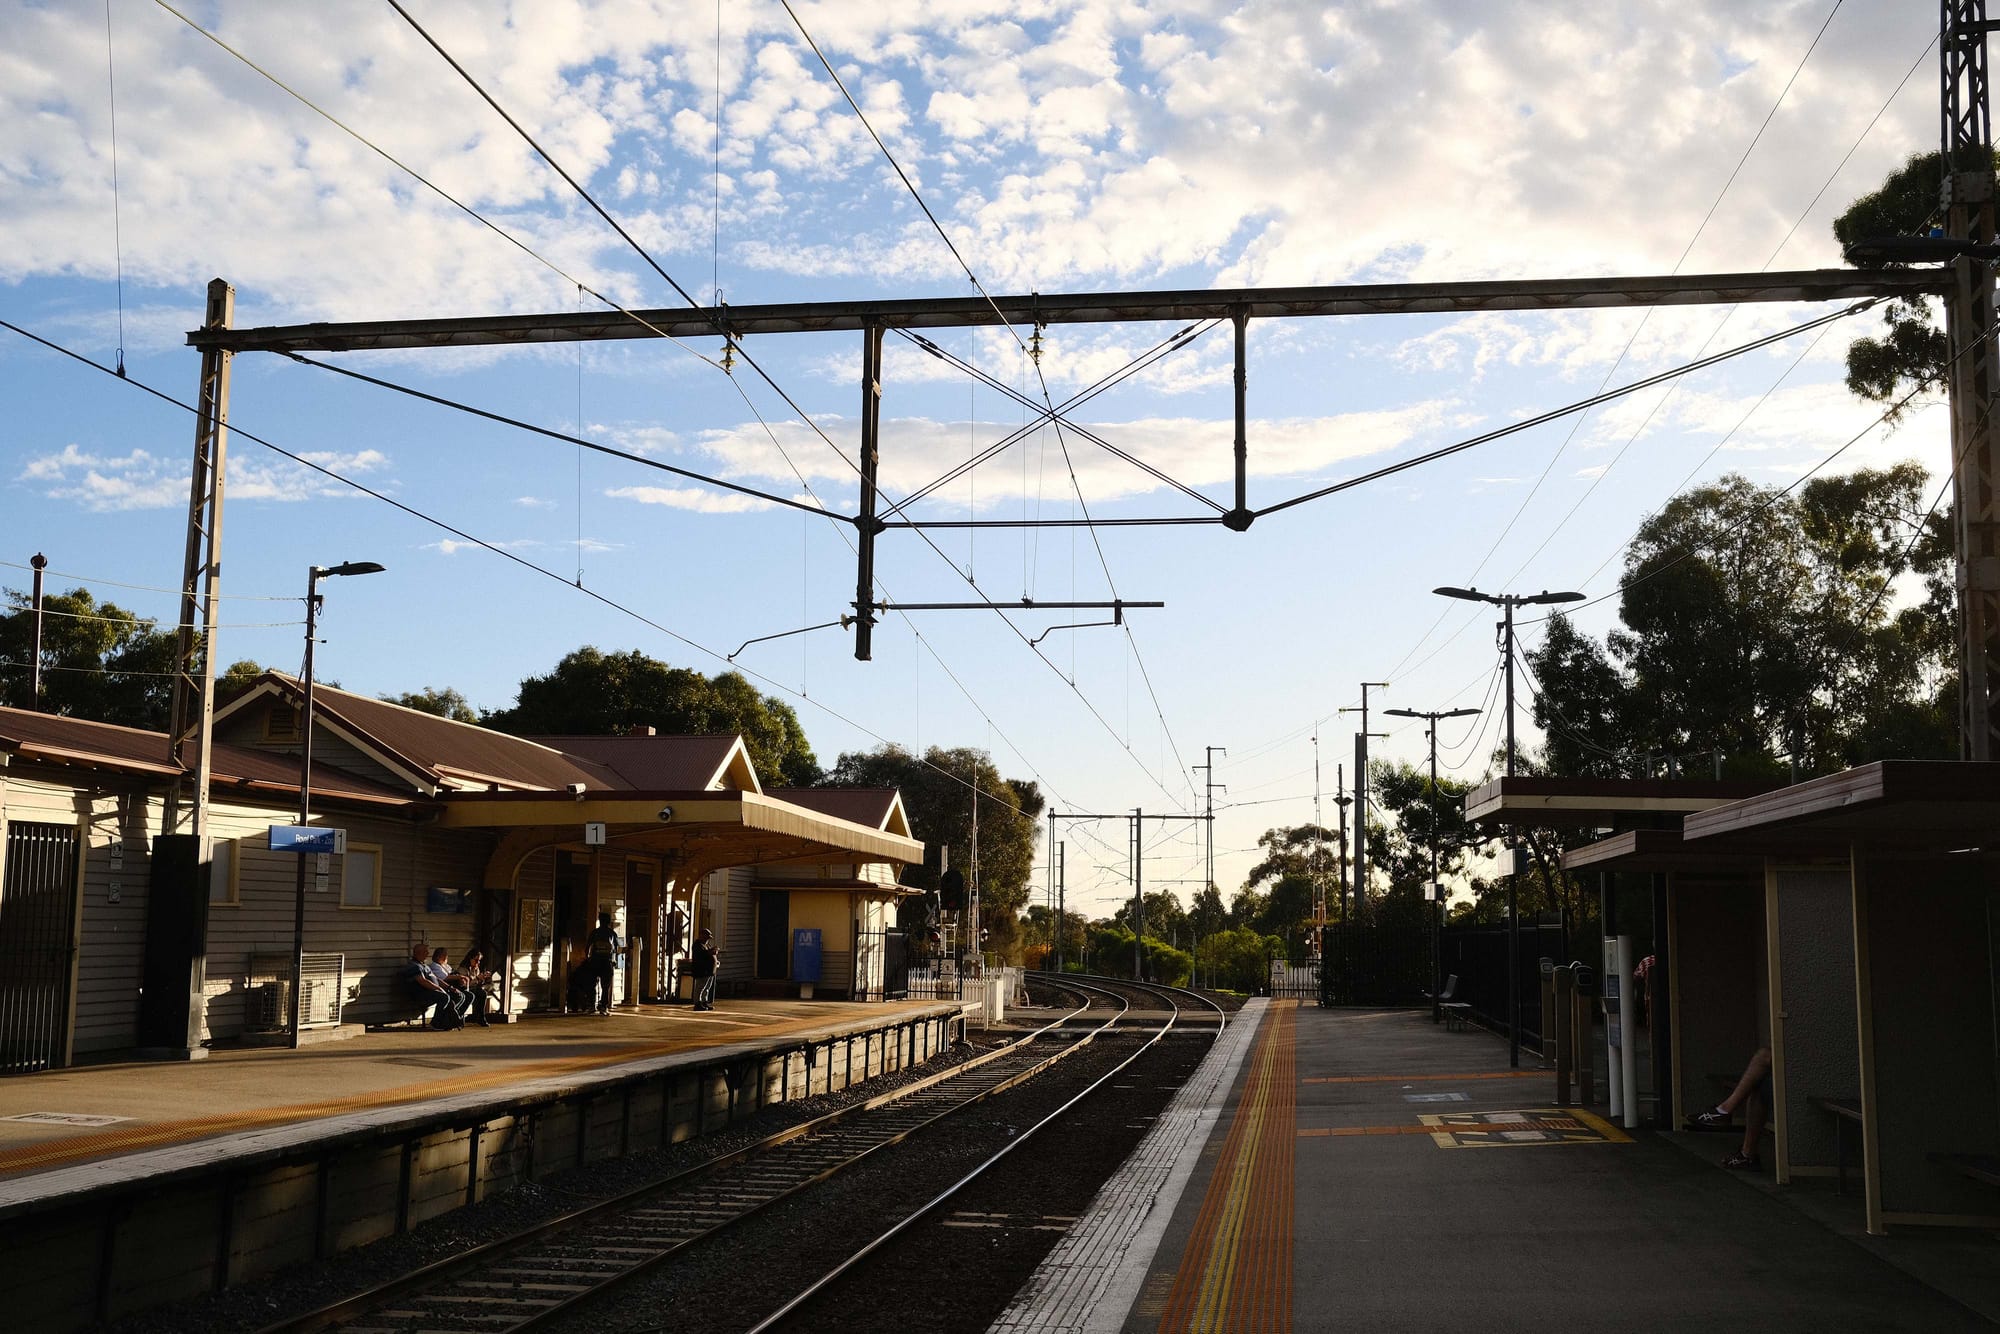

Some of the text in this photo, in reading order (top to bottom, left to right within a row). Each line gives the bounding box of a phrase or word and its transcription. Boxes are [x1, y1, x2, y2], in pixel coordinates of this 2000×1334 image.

[295, 833, 309, 845] Royal
[337, 831, 343, 852] 1
[591, 825, 599, 843] 1
